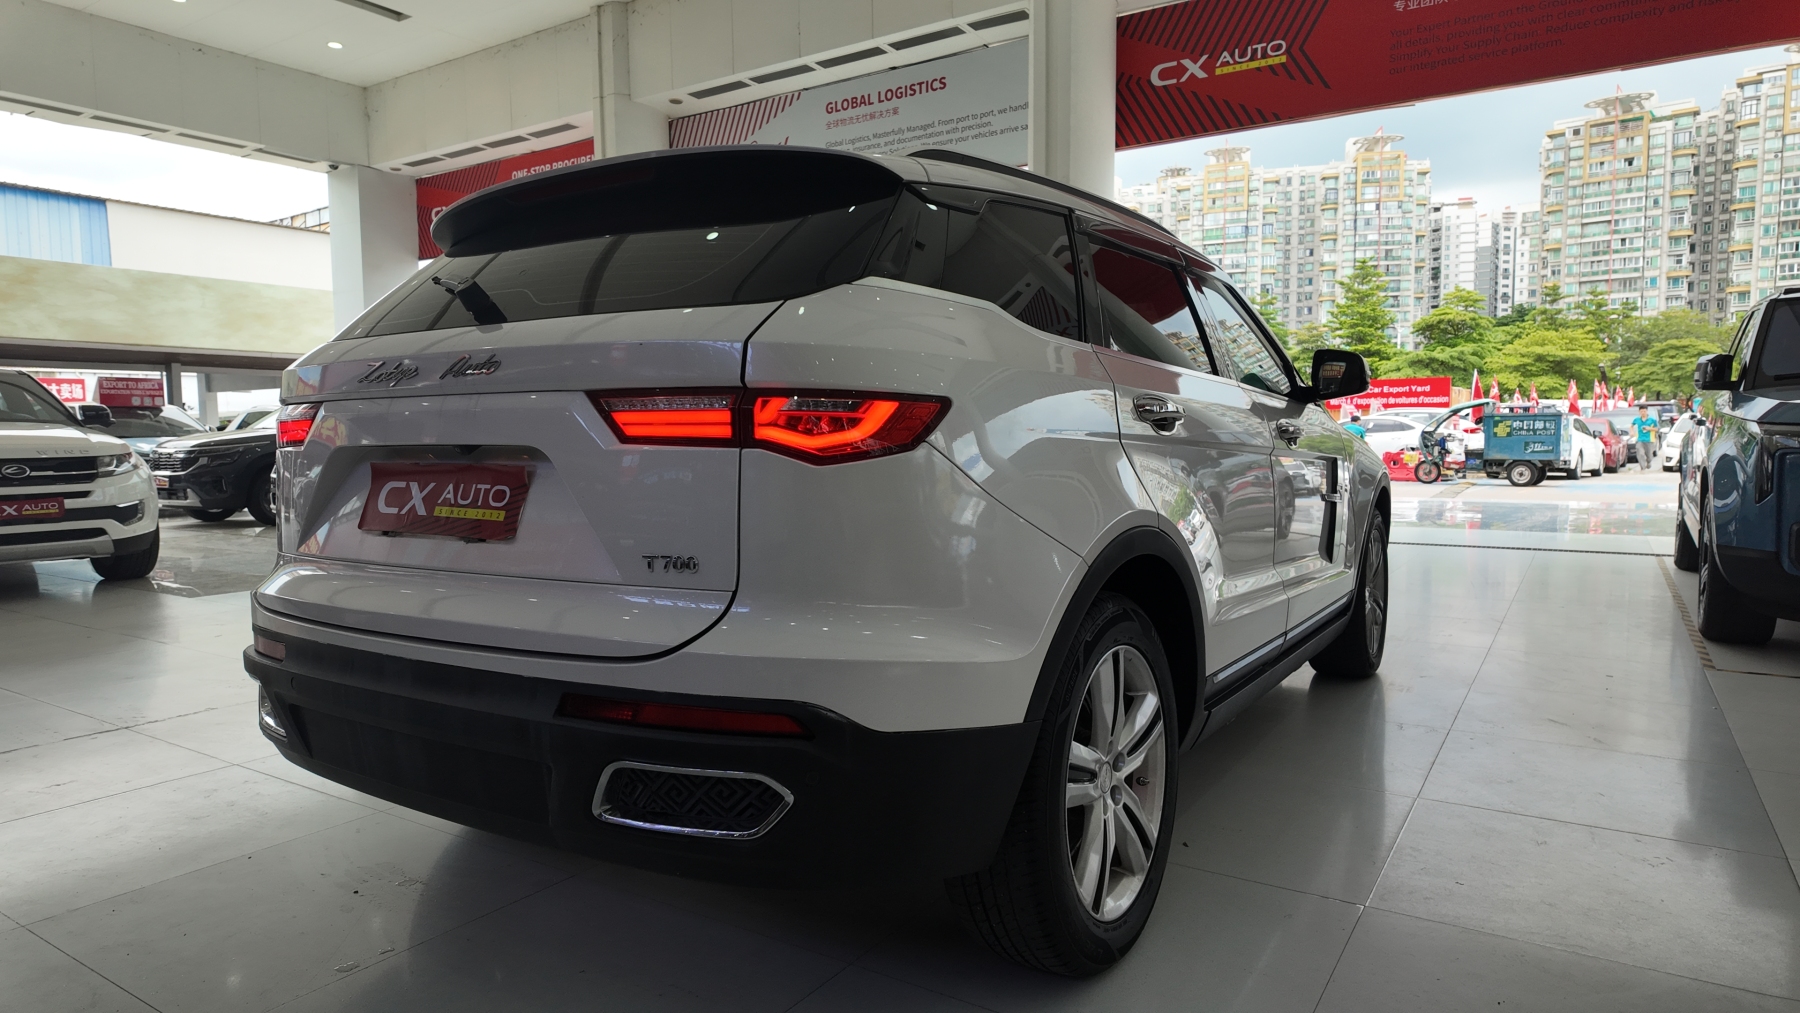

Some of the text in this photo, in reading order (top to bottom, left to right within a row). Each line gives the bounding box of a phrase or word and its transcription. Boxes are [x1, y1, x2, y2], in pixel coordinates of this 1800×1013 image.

[1389, 48, 1433, 63] Simplify
[1435, 44, 1460, 55] Your
[1463, 36, 1502, 50] Supply
[1505, 29, 1542, 42] Chain.
[1545, 20, 1590, 35] Reduce
[1593, 6, 1665, 25] complexity
[1669, 0, 1694, 13] and
[1390, 0, 1584, 37] Your Expert Partner on the Groun
[1446, 24, 1501, 42] providing
[1502, 20, 1524, 32] you
[1527, 13, 1553, 26] with
[1557, 8, 1586, 20] clear
[1150, 39, 1287, 87] CX AUTO
[1220, 63, 1250, 73] SINCE
[1389, 38, 1566, 75] our integrated service platform.
[825, 76, 947, 115] GLOBAL LOGISTICS
[825, 101, 1029, 149] Global Logistics, Masterfully Managed. From port to port, we handl
[883, 137, 896, 147] and
[896, 129, 944, 146] documentation
[945, 124, 960, 136] with
[961, 120, 994, 134] precision.
[954, 133, 970, 145] your
[970, 127, 998, 140] vehicles
[999, 125, 1020, 136] arrive
[438, 353, 501, 380] Auto
[1368, 384, 1430, 394] Car Export Yard
[1419, 395, 1449, 404] d'occasion
[0, 504, 19, 516] X
[22, 502, 59, 511] AUTO
[377, 480, 511, 516] CX AUTO
[438, 508, 501, 519] SINCE 2012
[642, 553, 700, 575] T700
